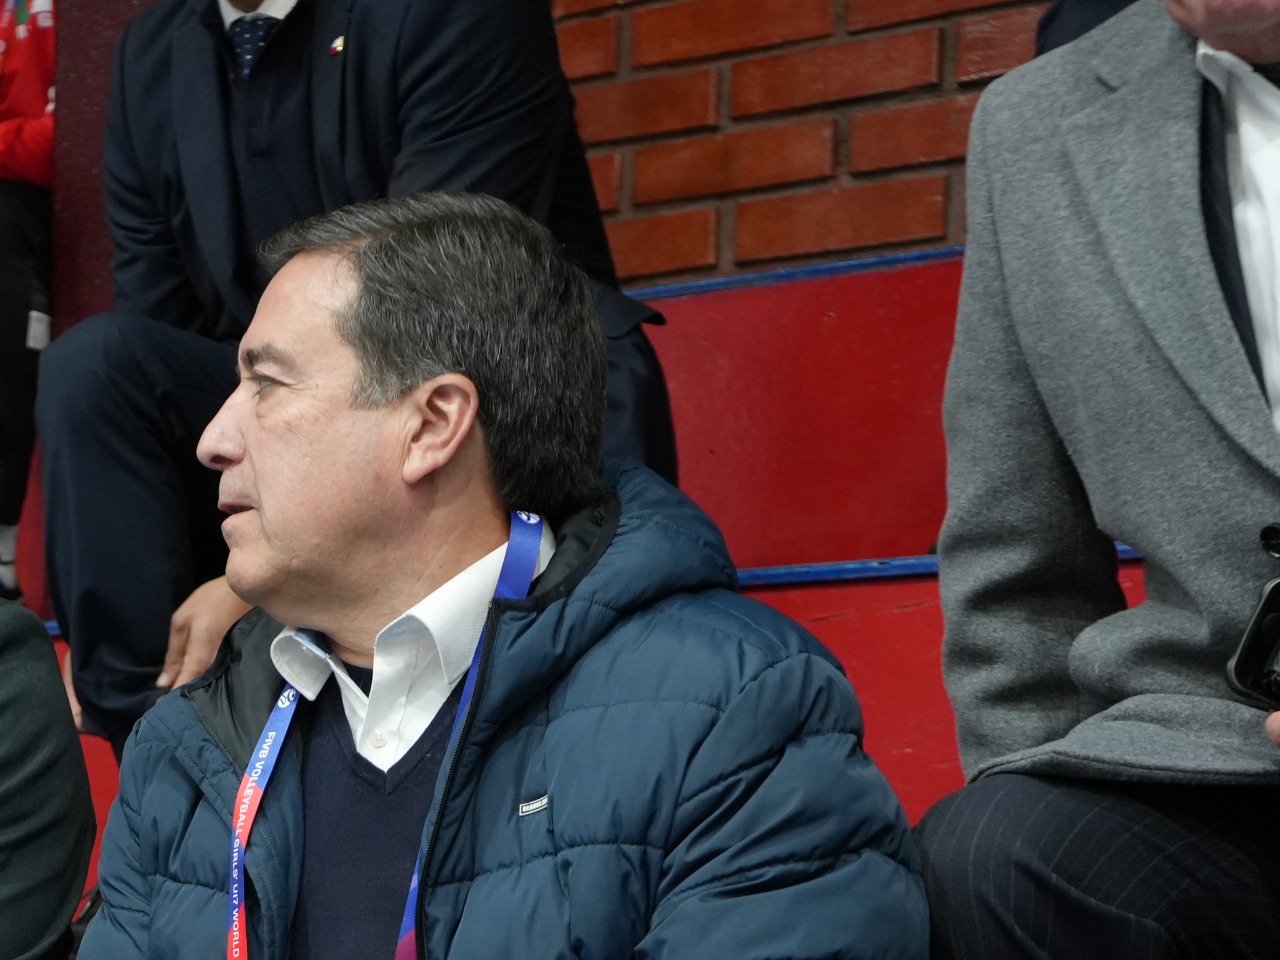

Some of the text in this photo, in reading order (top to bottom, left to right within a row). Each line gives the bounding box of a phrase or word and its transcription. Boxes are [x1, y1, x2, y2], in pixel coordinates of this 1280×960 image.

[258, 731, 277, 758] FIVB
[235, 760, 263, 836] VOLLEYBALL
[232, 838, 240, 879] GIRLS'
[232, 908, 240, 958] WORLD
